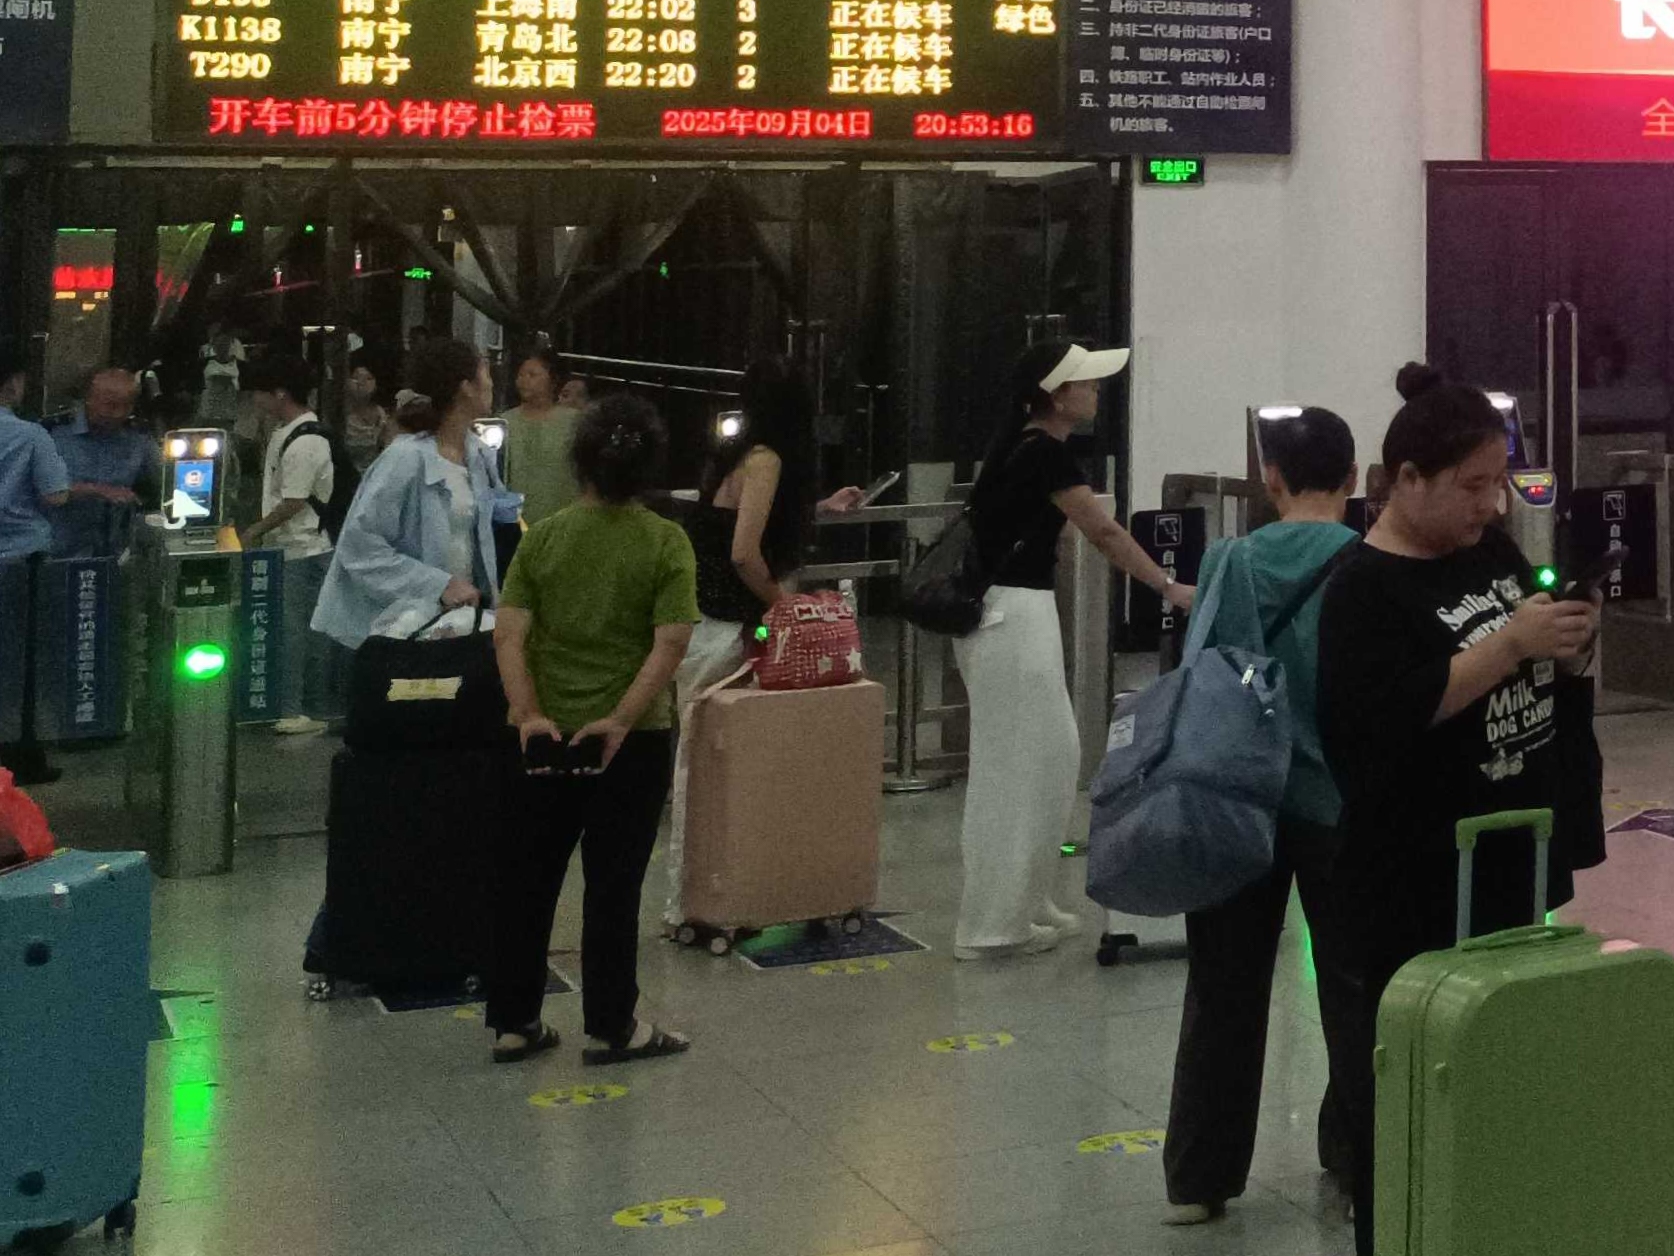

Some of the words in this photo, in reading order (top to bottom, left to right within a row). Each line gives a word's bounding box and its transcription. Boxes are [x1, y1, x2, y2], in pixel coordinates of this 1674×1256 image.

[0, 0, 56, 20] 闸机
[830, 1, 953, 30] 正在候车
[995, 5, 1056, 34] 绿色
[179, 16, 281, 42] K1138
[341, 19, 410, 49] 南宁
[476, 24, 577, 54] 青岛北
[607, 29, 696, 53] 22:08
[739, 31, 756, 56] 2
[830, 33, 953, 61] 正在候车
[190, 51, 270, 78] T290
[340, 54, 410, 85] 南宁
[474, 57, 576, 88] 北京西
[606, 62, 696, 89] 22:20
[737, 65, 755, 90] 2
[829, 65, 953, 95] 正在候车
[210, 98, 596, 137] 开车前5分钟停止检票
[663, 109, 871, 137] 2025年09月04日
[916, 114, 1032, 138] 20:53:16
[1486, 678, 1537, 722] Milk
[1487, 716, 1518, 743] DOG
